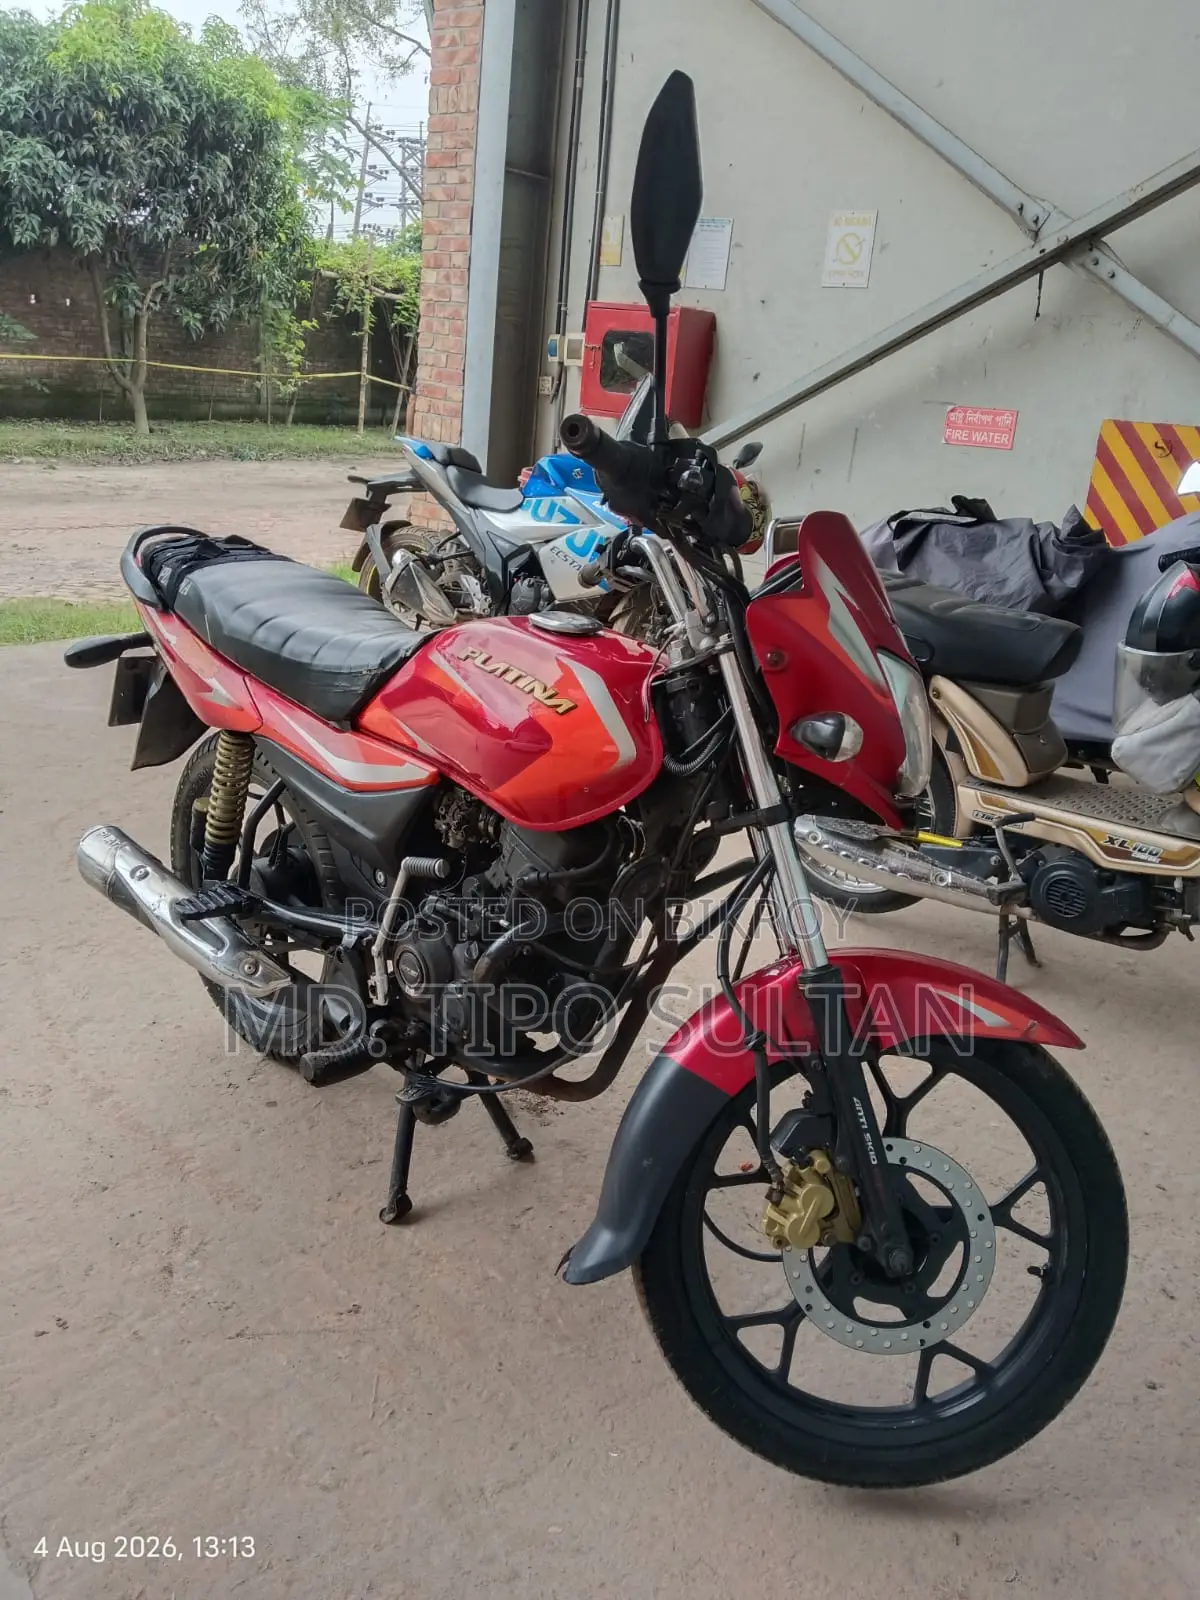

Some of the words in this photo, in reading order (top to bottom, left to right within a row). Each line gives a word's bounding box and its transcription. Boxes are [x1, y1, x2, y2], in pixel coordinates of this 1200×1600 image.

[945, 428, 969, 441] FIRE
[971, 431, 1009, 445] WATER
[549, 546, 586, 573] ECSTA
[457, 646, 577, 715] PLATINA
[853, 1097, 868, 1128] ANTI
[864, 1133, 877, 1165] SKID
